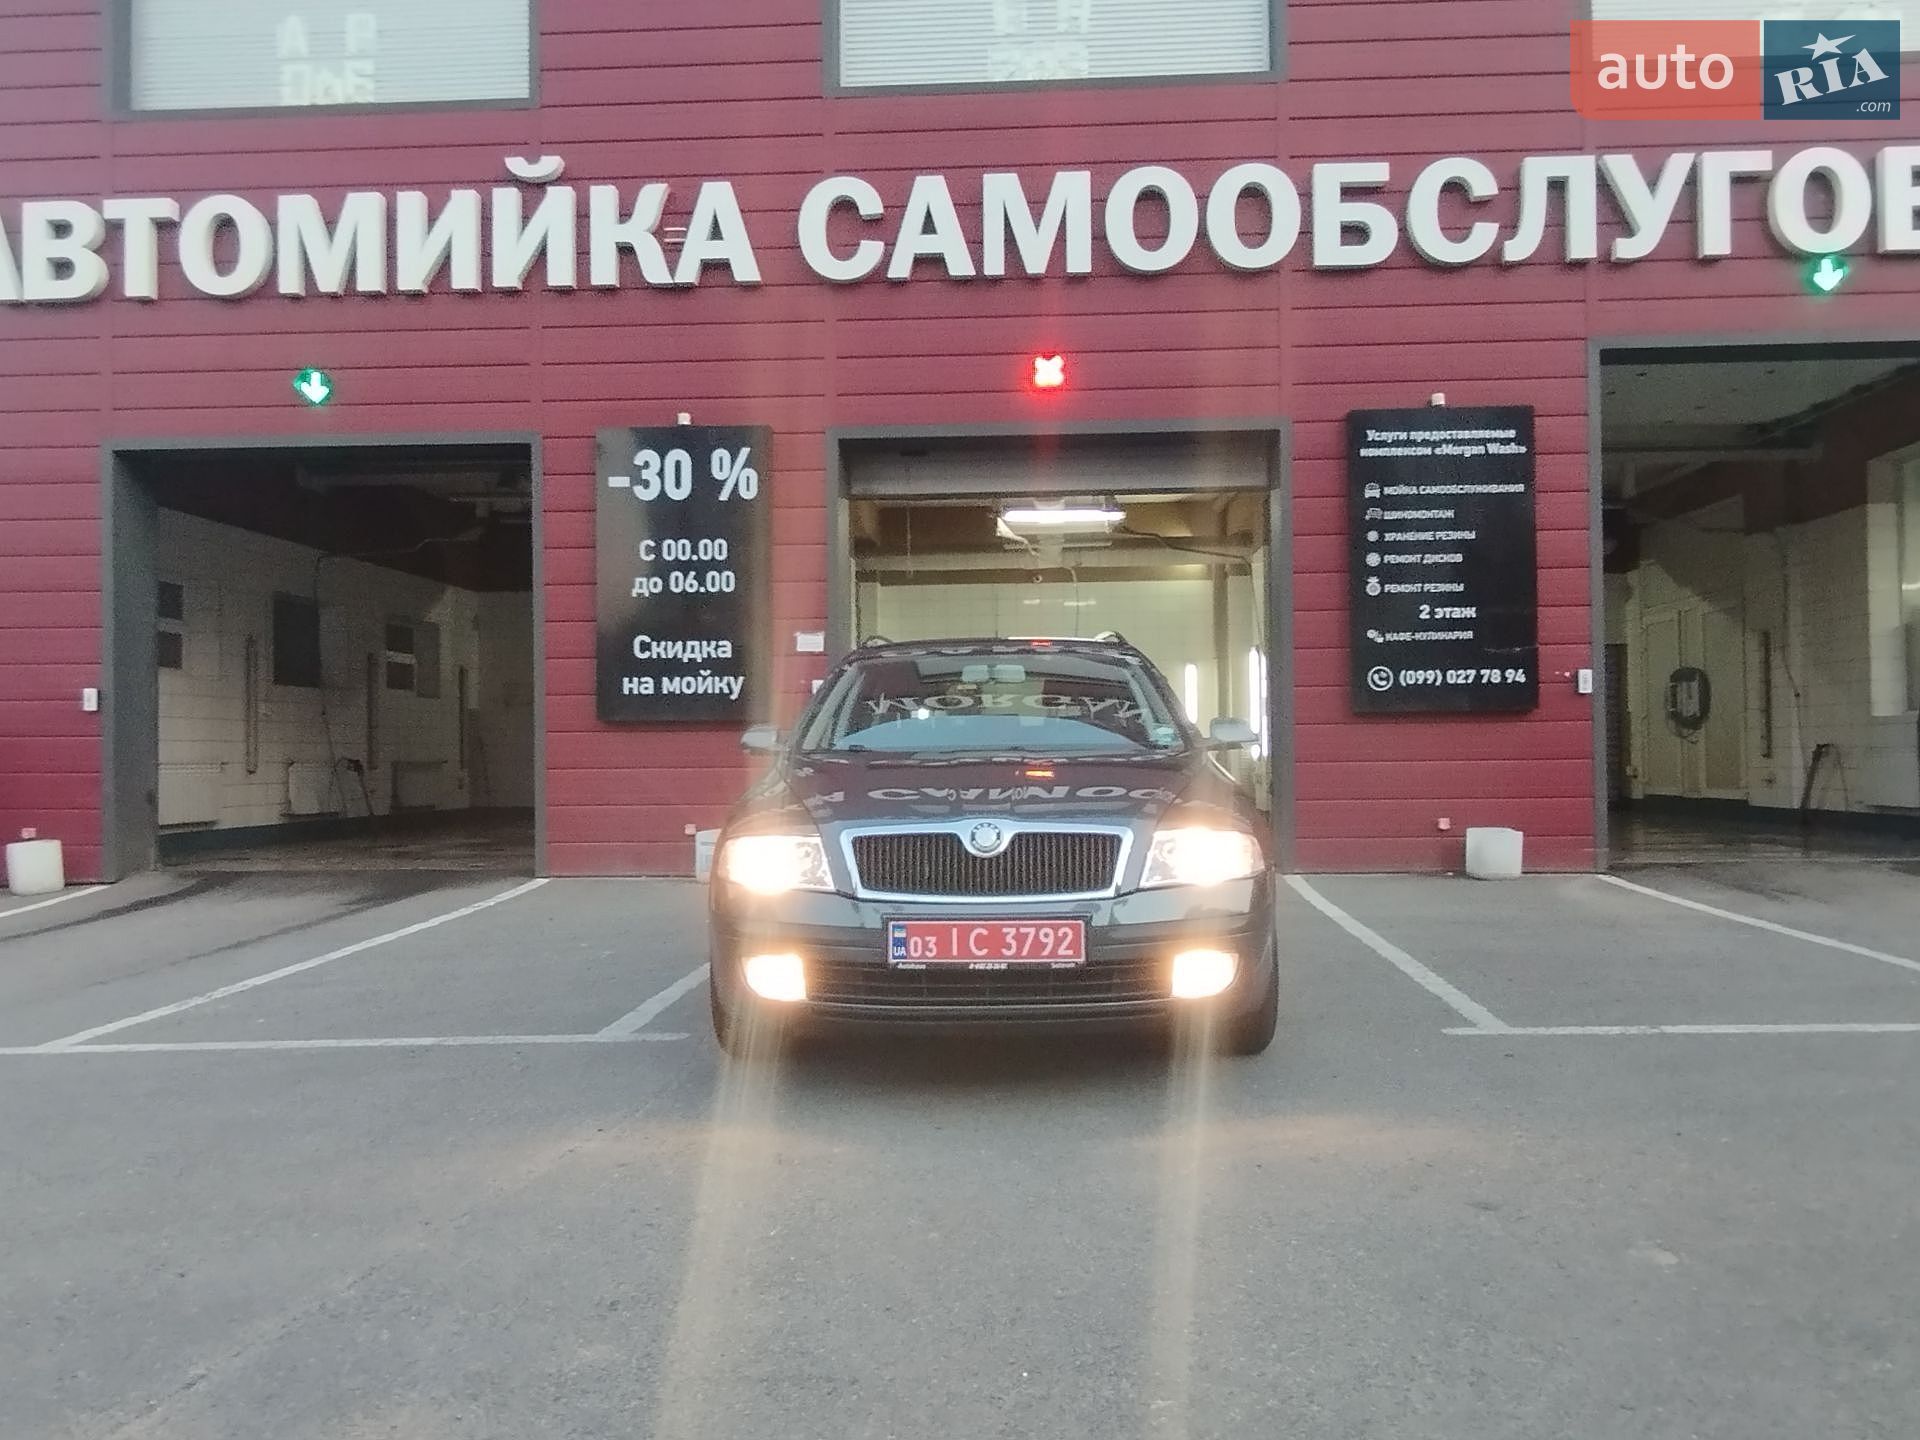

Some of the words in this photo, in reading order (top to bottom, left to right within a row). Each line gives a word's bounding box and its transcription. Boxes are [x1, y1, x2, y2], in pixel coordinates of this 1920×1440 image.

[0, 155, 762, 302] ВТОМИЙКА
[608, 449, 692, 501] -30
[711, 447, 759, 501] %
[662, 538, 728, 561] 00.00
[632, 577, 663, 597] до
[669, 570, 736, 593] 06.00
[1419, 604, 1431, 619] 2
[1434, 607, 1477, 619] этаж
[633, 635, 732, 662] Скидка
[622, 676, 654, 694] на
[662, 669, 744, 700] мойку
[1399, 669, 1443, 686] (099)
[1446, 669, 1476, 684] 027
[1480, 669, 1501, 683] 78
[1505, 668, 1526, 683] 94
[910, 937, 937, 957] 03
[1002, 927, 1074, 956] 3792
